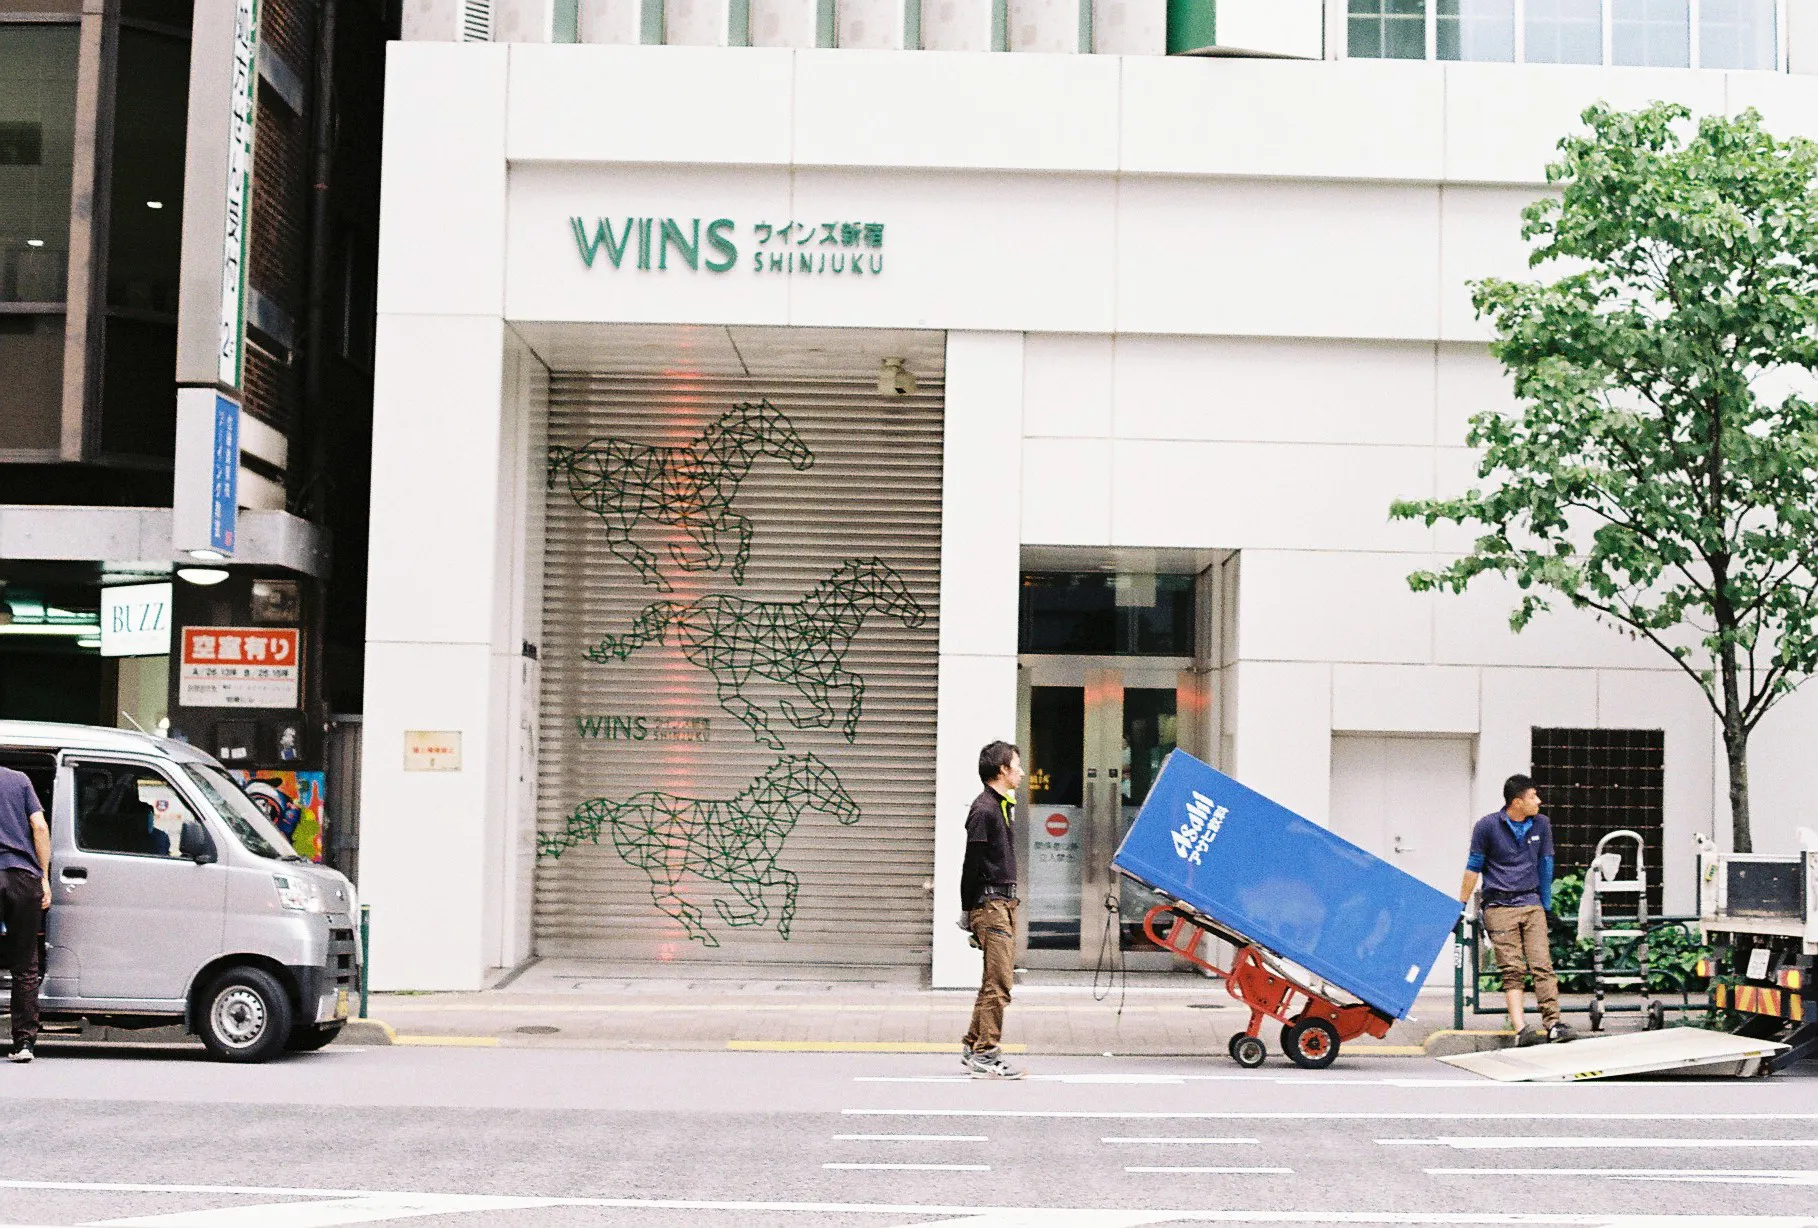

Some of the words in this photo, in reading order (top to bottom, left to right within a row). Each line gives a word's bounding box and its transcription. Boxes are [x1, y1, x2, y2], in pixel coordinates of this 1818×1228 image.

[569, 216, 738, 273] WINS
[753, 220, 885, 248] ウインズ新宿
[753, 252, 884, 275] SHINJUKU
[112, 602, 165, 633] BUZZ
[191, 635, 290, 661] 空室有り
[575, 715, 648, 740] WINS
[1170, 790, 1215, 859] Asahi
